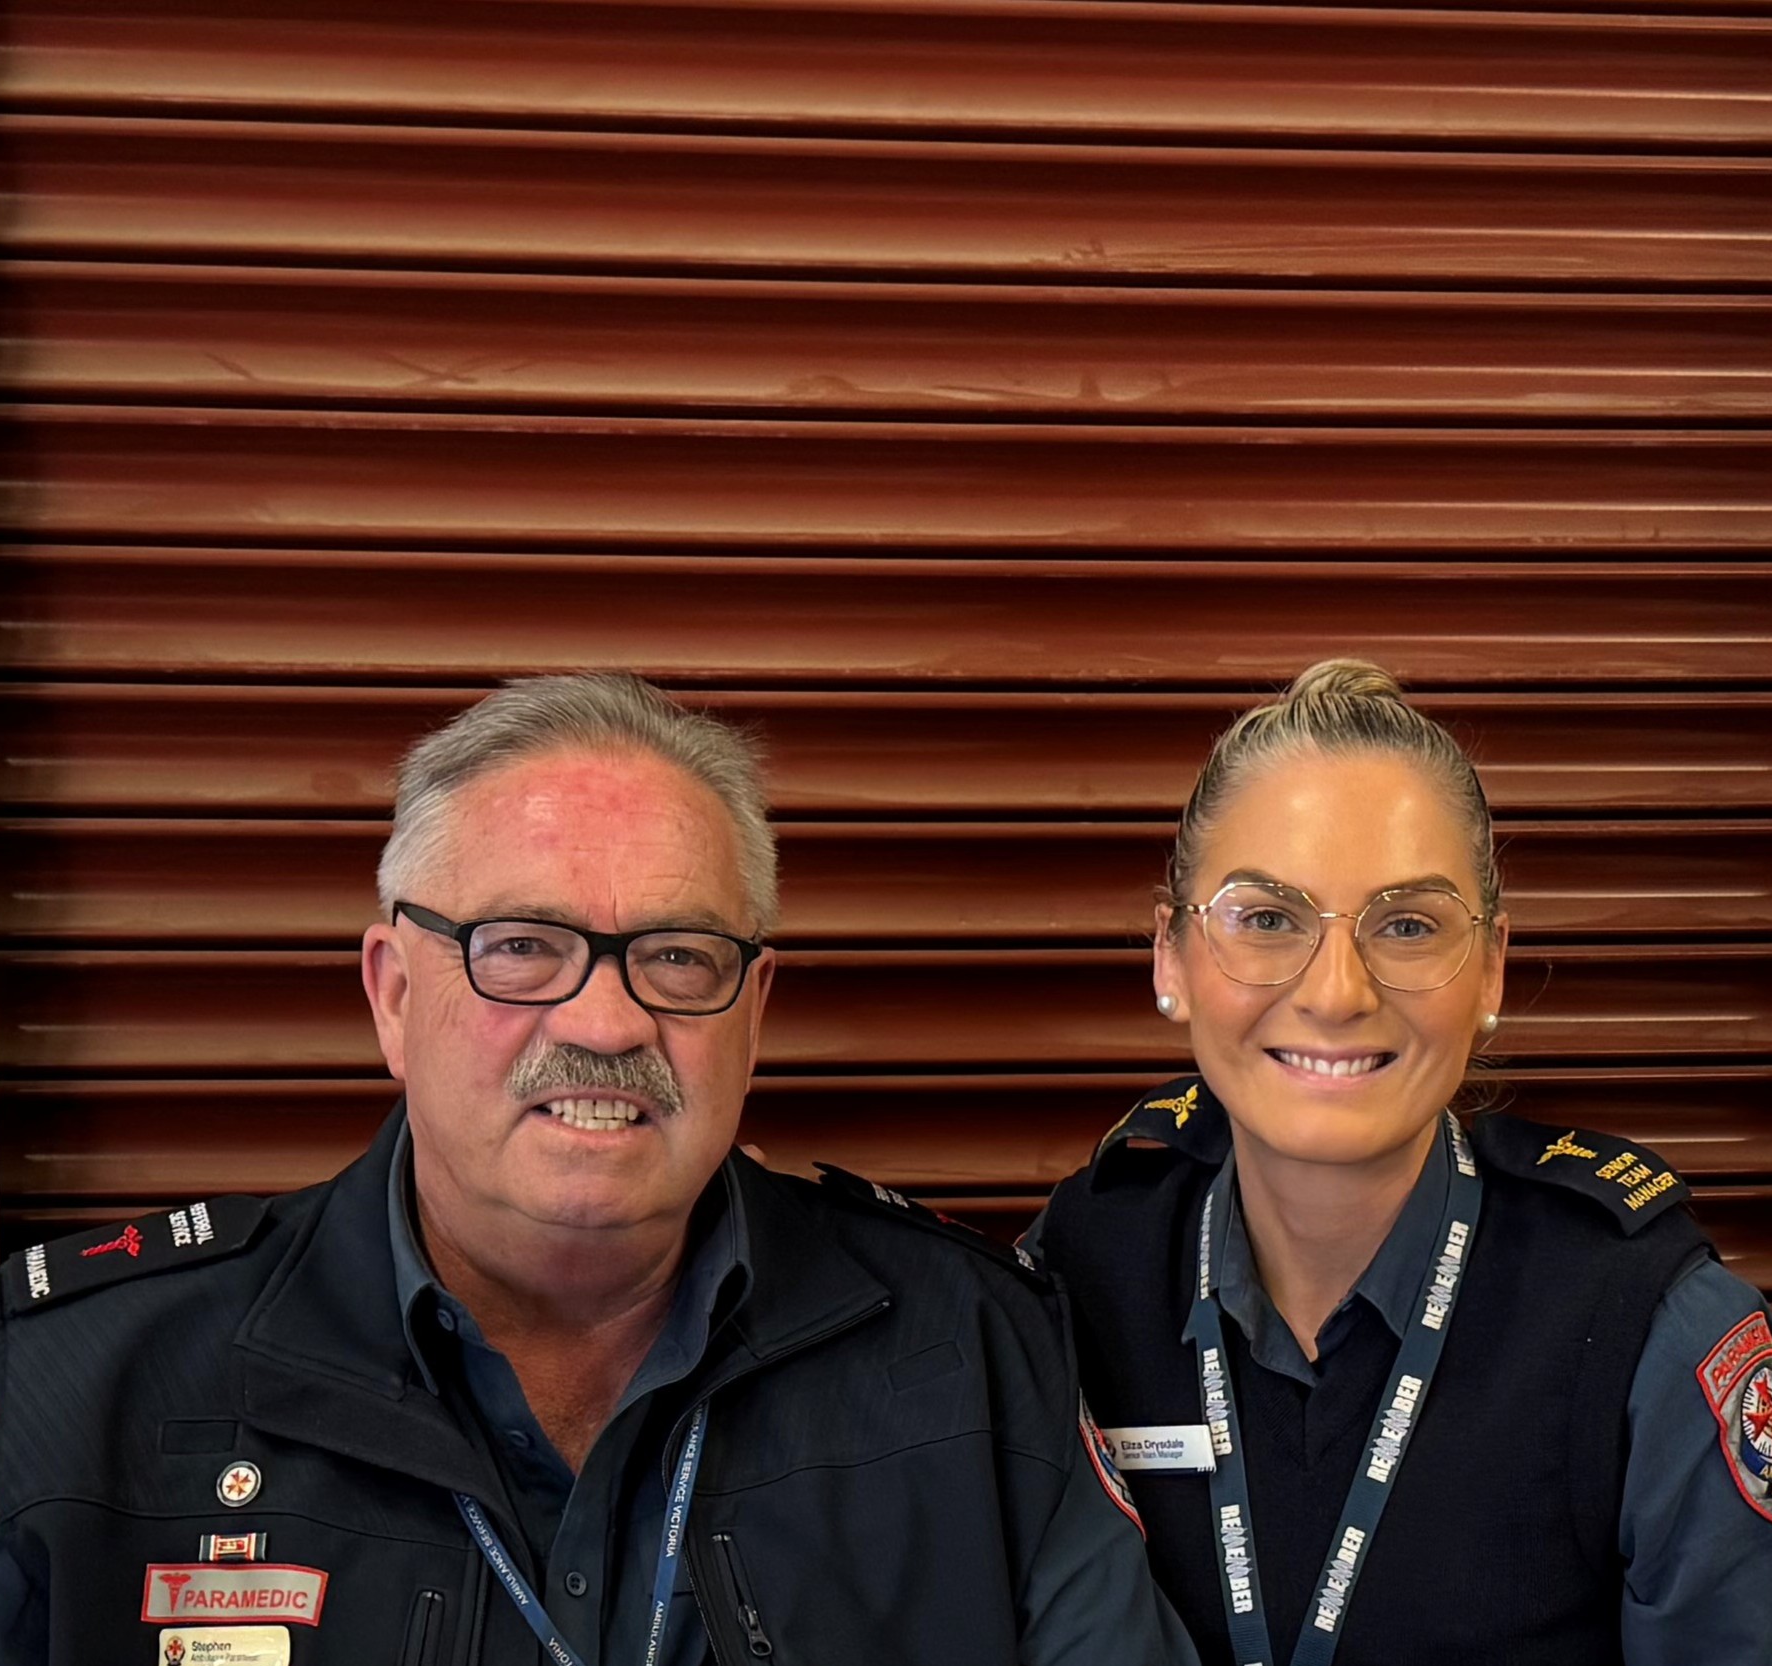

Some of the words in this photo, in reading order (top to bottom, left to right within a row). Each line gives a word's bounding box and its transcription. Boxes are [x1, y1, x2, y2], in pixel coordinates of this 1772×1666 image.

[1595, 1151, 1639, 1181] SENIOR
[1617, 1164, 1653, 1188] TEAM
[1623, 1172, 1677, 1211] MANAGER
[183, 1588, 309, 1609] PARAMEDIC
[192, 1640, 232, 1651] Stephen
